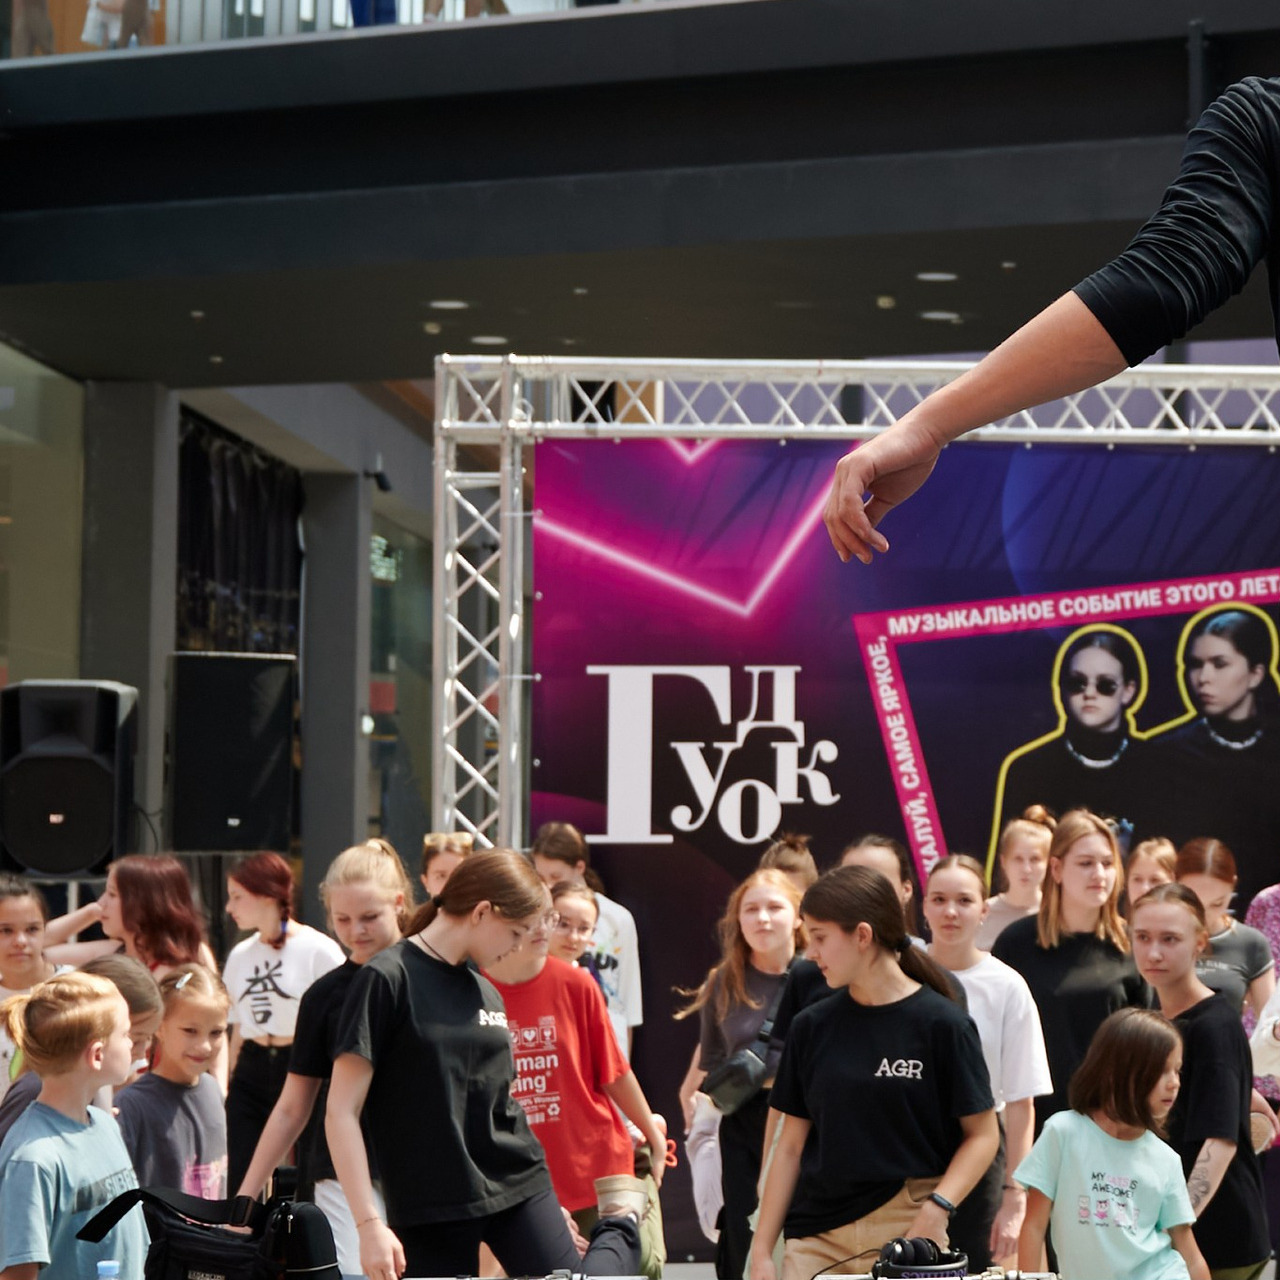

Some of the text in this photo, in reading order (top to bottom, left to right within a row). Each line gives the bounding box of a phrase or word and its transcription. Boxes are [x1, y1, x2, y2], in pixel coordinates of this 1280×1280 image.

[887, 599, 1055, 637] МУЗЫКАЛЬНОЕ
[1058, 587, 1162, 618] СОБЫТИЕ
[1165, 580, 1234, 606] ЭТОГО
[867, 634, 902, 713] ЯРКОЕ,
[886, 713, 921, 790] САМОЕ
[515, 1054, 559, 1072] man
[874, 1057, 924, 1080] AGR
[1091, 1171, 1106, 1181] MY
[1091, 1182, 1134, 1198] AWEOME!
